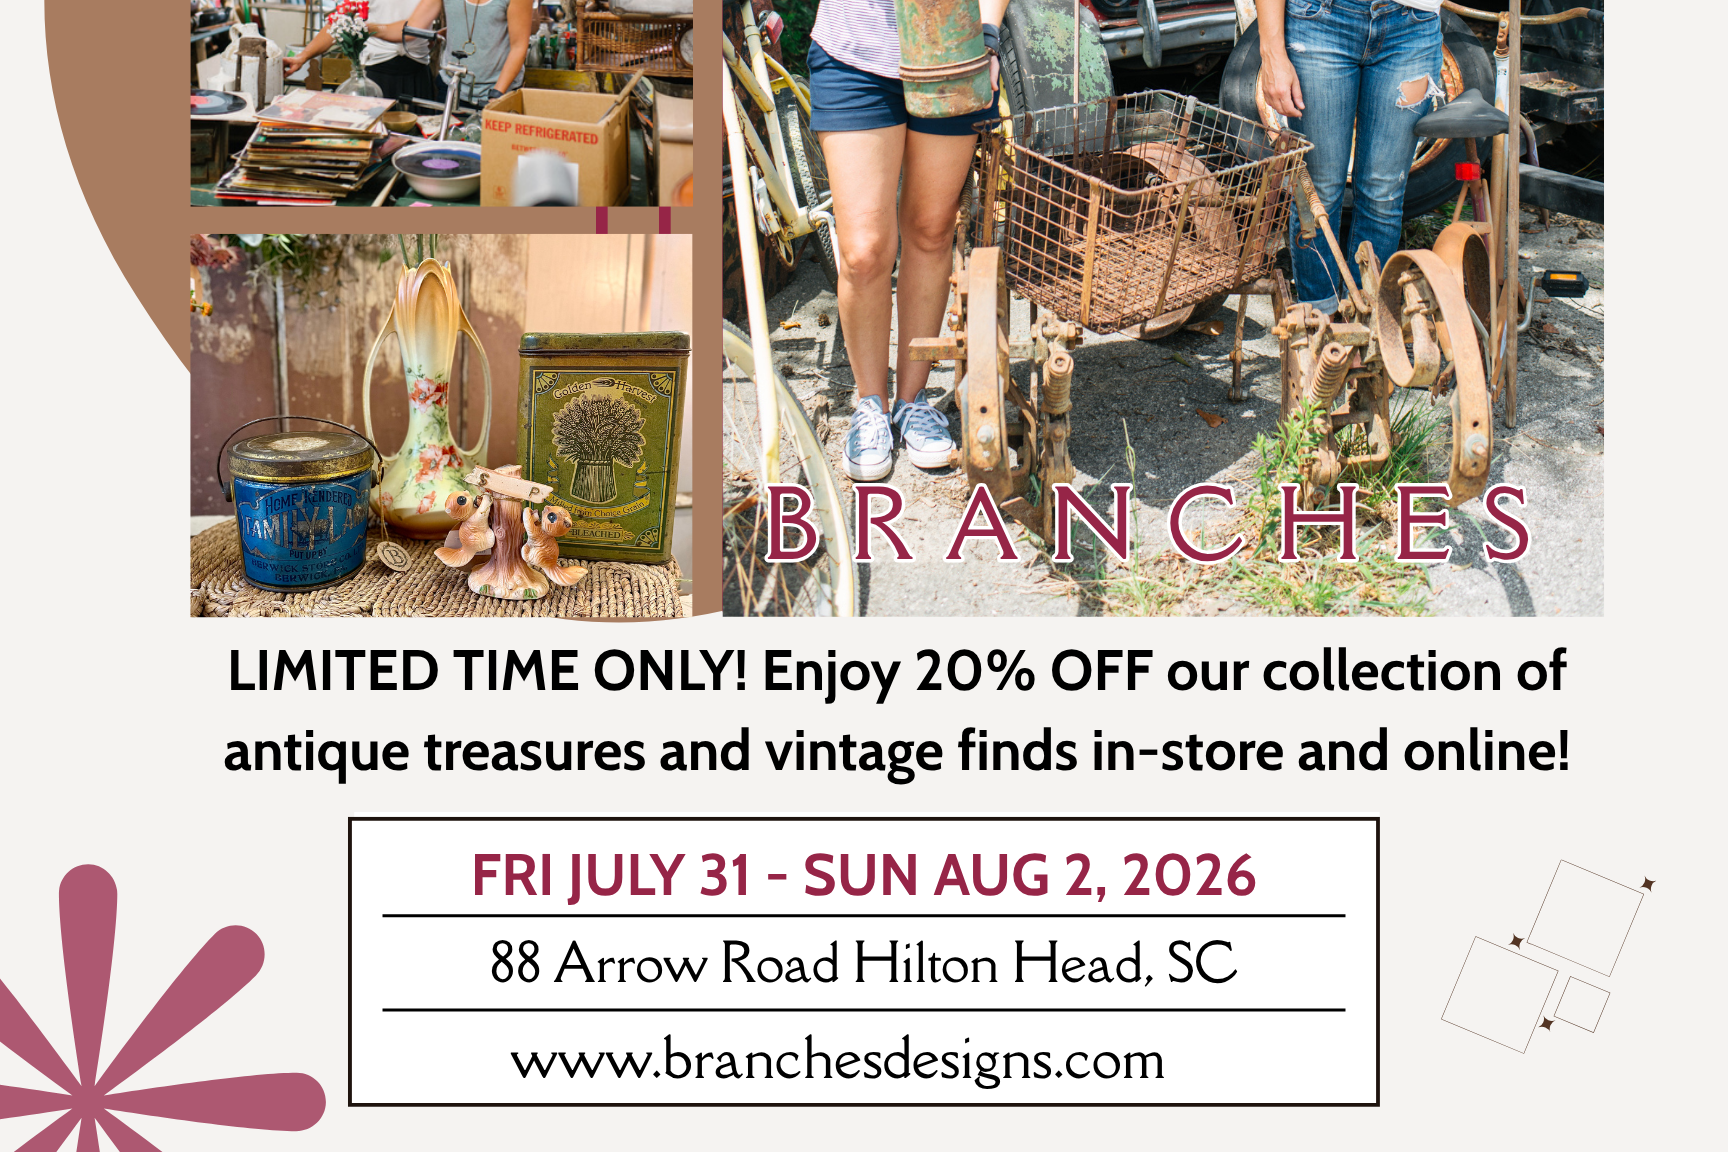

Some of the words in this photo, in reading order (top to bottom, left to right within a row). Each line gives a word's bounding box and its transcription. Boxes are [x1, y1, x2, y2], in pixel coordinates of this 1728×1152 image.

[485, 118, 512, 133] KEEP
[515, 123, 599, 146] REFRIGERATED
[553, 382, 592, 399] Golden
[615, 380, 657, 404] Harvest
[265, 493, 299, 516] HOME
[594, 509, 621, 518] Choice
[623, 501, 645, 514] Grain
[245, 506, 320, 550] FAMILY
[251, 559, 299, 573] BERWICK
[289, 549, 303, 560] PUT
[305, 551, 317, 560] UP
[318, 547, 328, 557] BY
[231, 650, 438, 690] LIMITED
[454, 650, 578, 690] TIME
[595, 649, 745, 691] ONLY!
[766, 650, 901, 704] Enjoy
[917, 649, 1035, 691] 20%
[1052, 649, 1153, 691] OFF
[1168, 661, 1249, 691] our
[1264, 647, 1500, 691] collection
[1518, 647, 1567, 691] of
[225, 730, 409, 784] antique
[424, 734, 645, 771] treasures
[660, 727, 749, 771] and
[765, 730, 942, 785] vintage
[958, 727, 1077, 771] finds
[1094, 730, 1283, 771] in-store
[1299, 727, 1387, 771] and
[1405, 727, 1570, 771] online!
[475, 854, 550, 895] FRI
[568, 854, 685, 905] JULY
[701, 853, 746, 896] 31
[805, 853, 916, 896] SUN
[934, 853, 1047, 896] AUG
[1066, 853, 1106, 903] 2,
[1124, 853, 1256, 896] 2026
[491, 940, 539, 983] 88
[554, 941, 708, 983] Arrow
[723, 940, 838, 983] Road
[856, 940, 997, 983] Hilton
[1015, 940, 1154, 987] Head,
[1169, 940, 1238, 983] SC
[511, 1034, 1164, 1089] www.branchesdesigns.com
